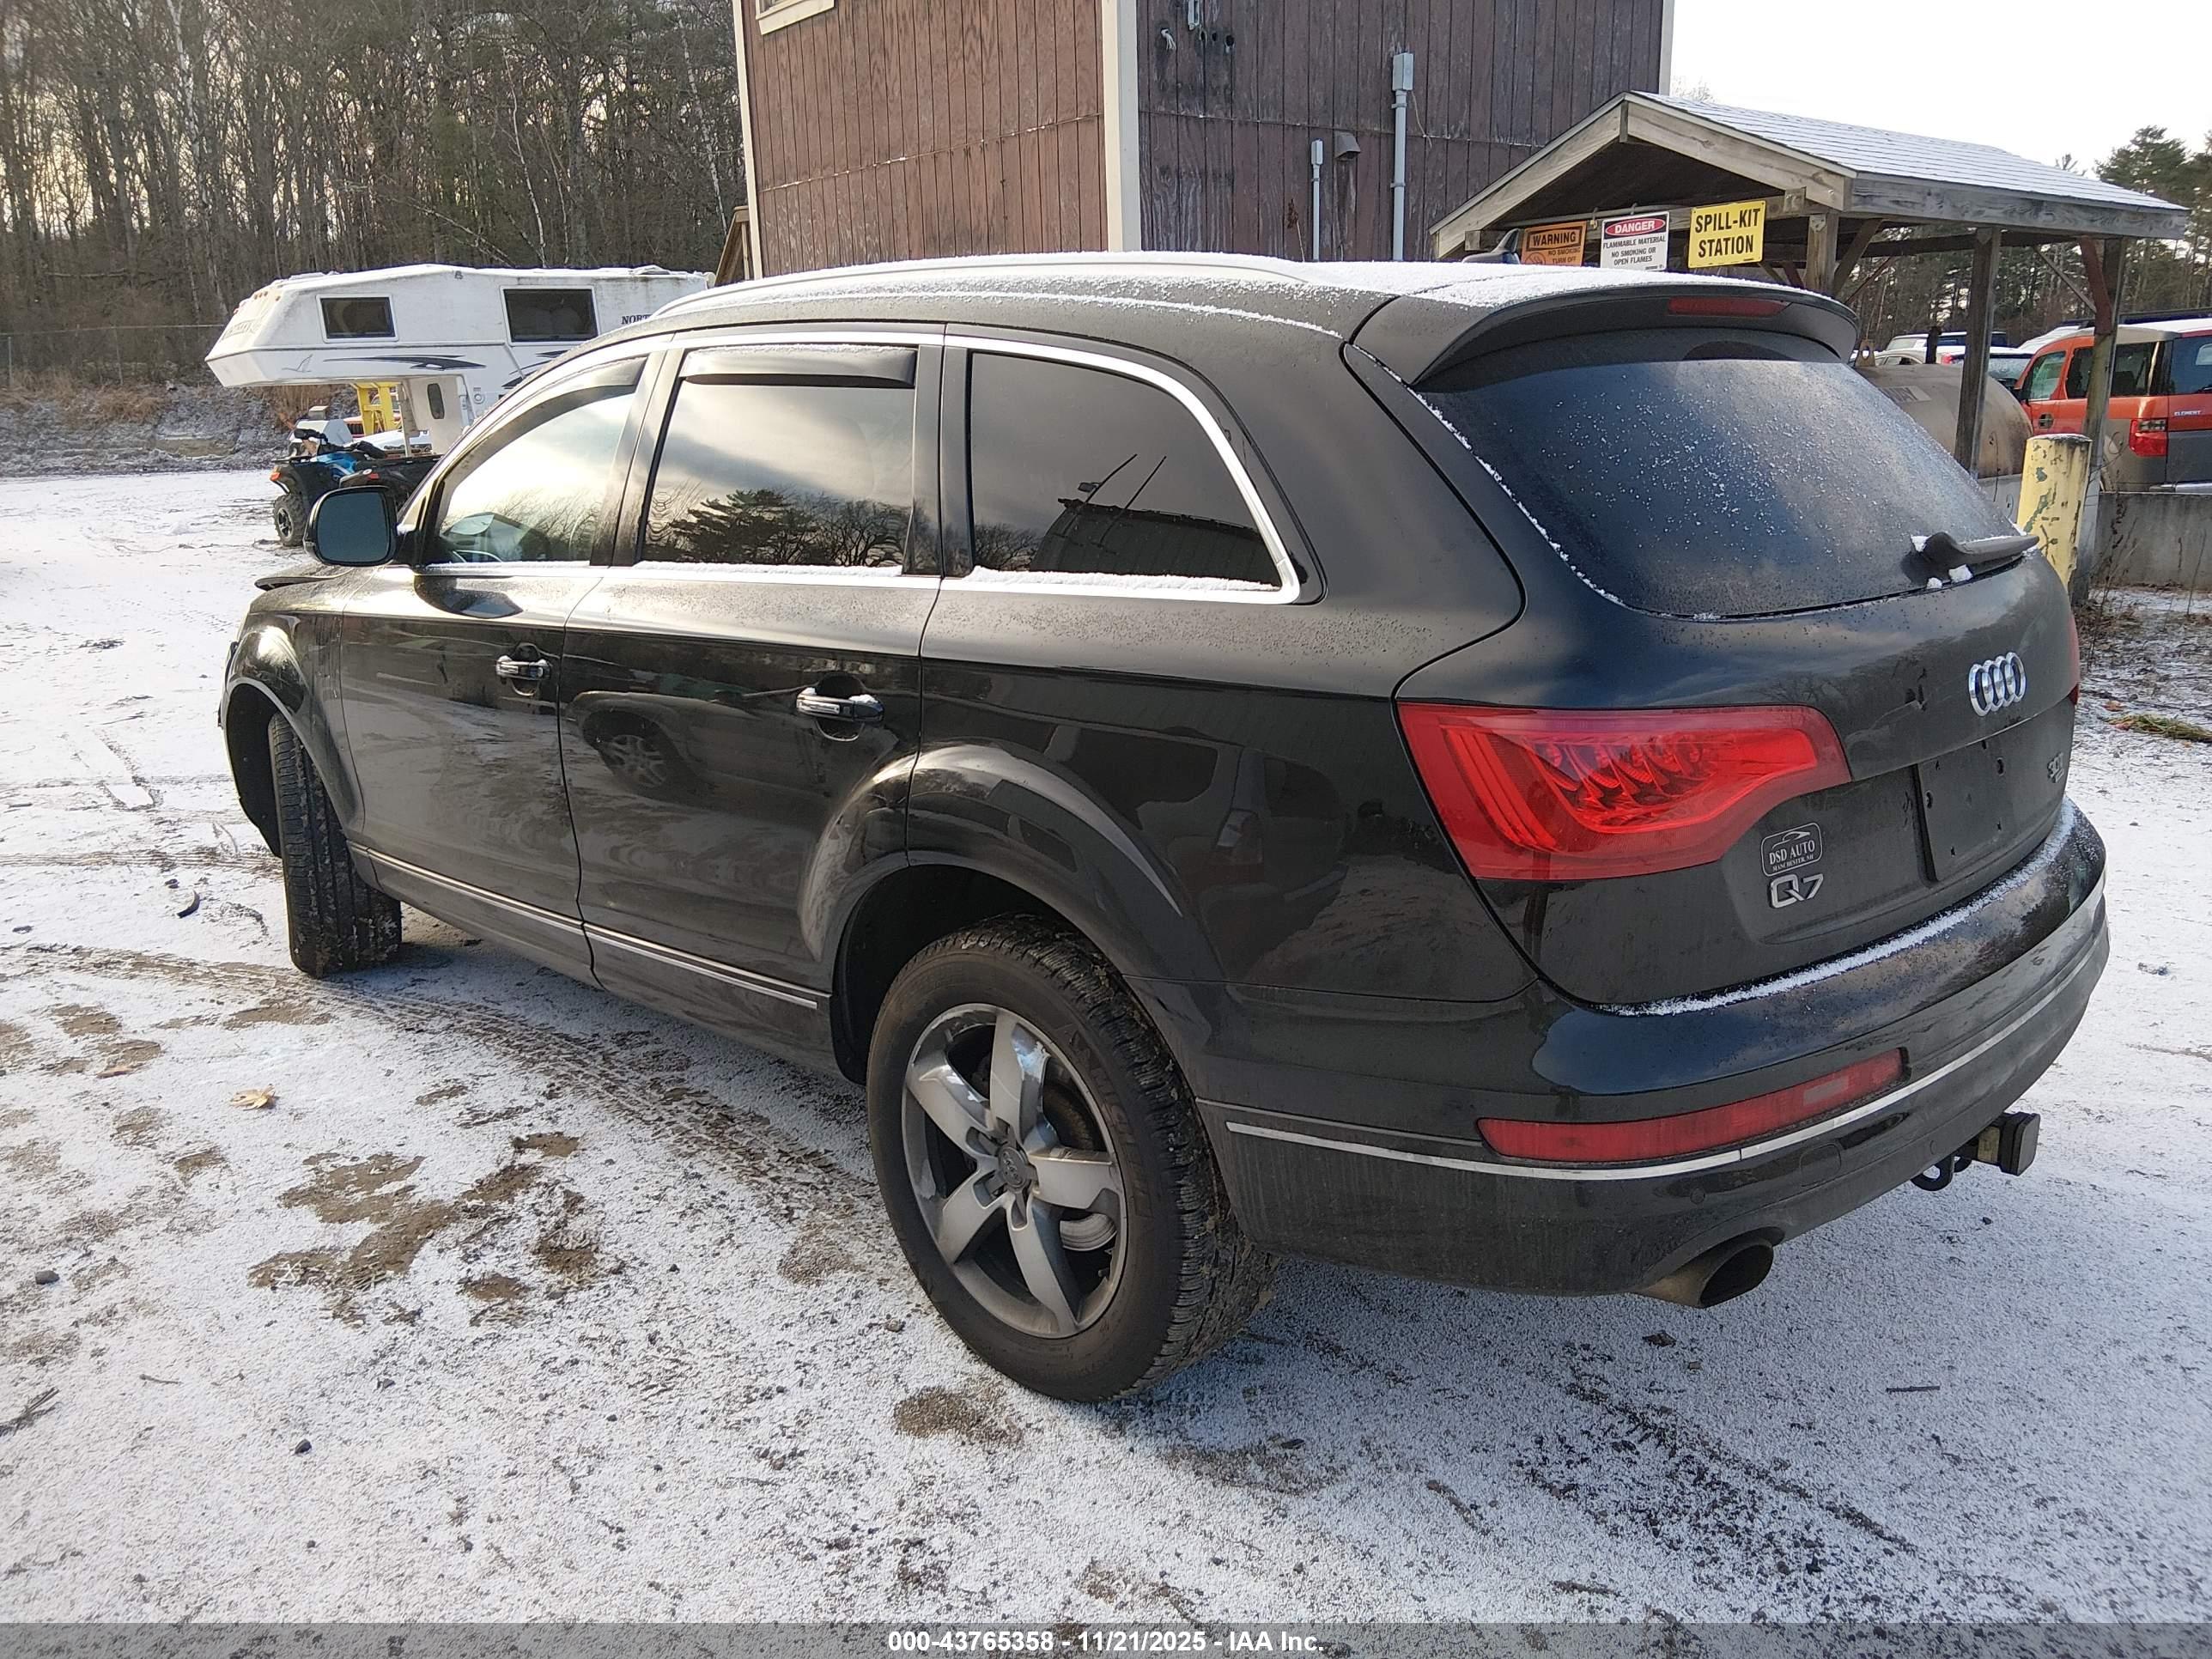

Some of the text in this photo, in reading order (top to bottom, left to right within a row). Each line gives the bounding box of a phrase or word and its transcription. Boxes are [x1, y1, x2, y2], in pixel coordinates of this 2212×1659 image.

[1615, 221, 1655, 234] DANGER
[1695, 209, 1760, 233] SPILL-KIT
[1533, 232, 1576, 246] WARNING
[1603, 235, 1666, 249] FLAMMABLE MATERIAL
[1698, 235, 1753, 258] STATION
[1769, 840, 1815, 865] DSD AUTO
[1770, 873, 1824, 908] Q7
